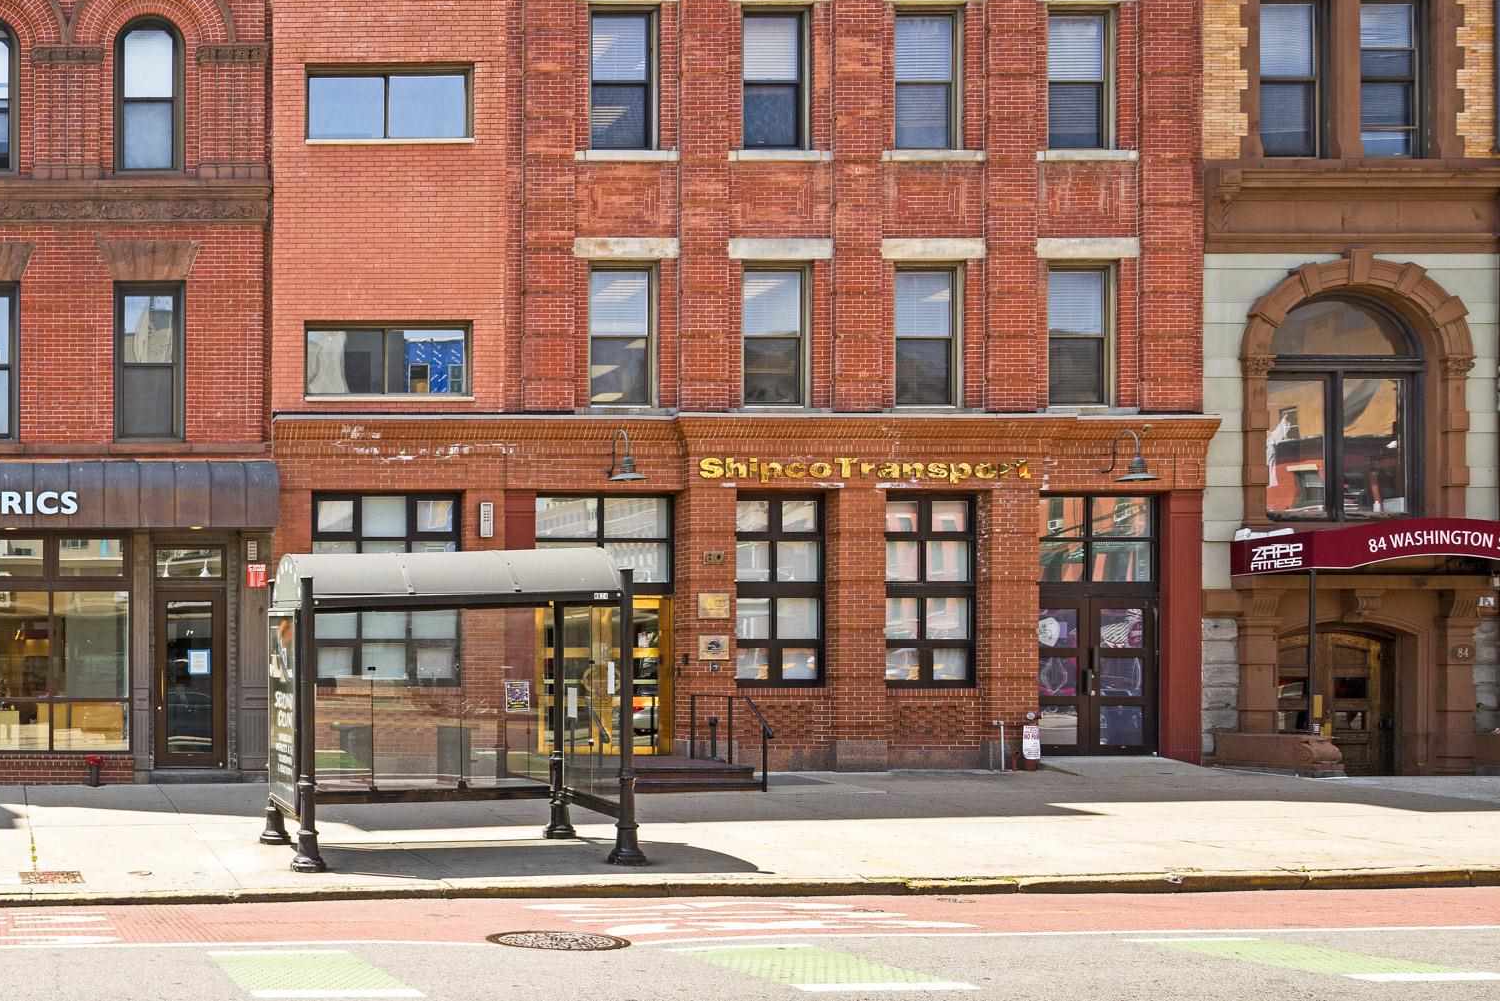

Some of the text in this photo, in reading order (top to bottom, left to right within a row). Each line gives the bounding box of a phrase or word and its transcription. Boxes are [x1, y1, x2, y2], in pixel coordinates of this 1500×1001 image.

[1368, 536, 1388, 553] 84
[1388, 530, 1494, 549] WASHINGTON
[1251, 543, 1303, 561] ZAPP
[1250, 557, 1303, 571] FITNESS
[1457, 647, 1469, 658] 84
